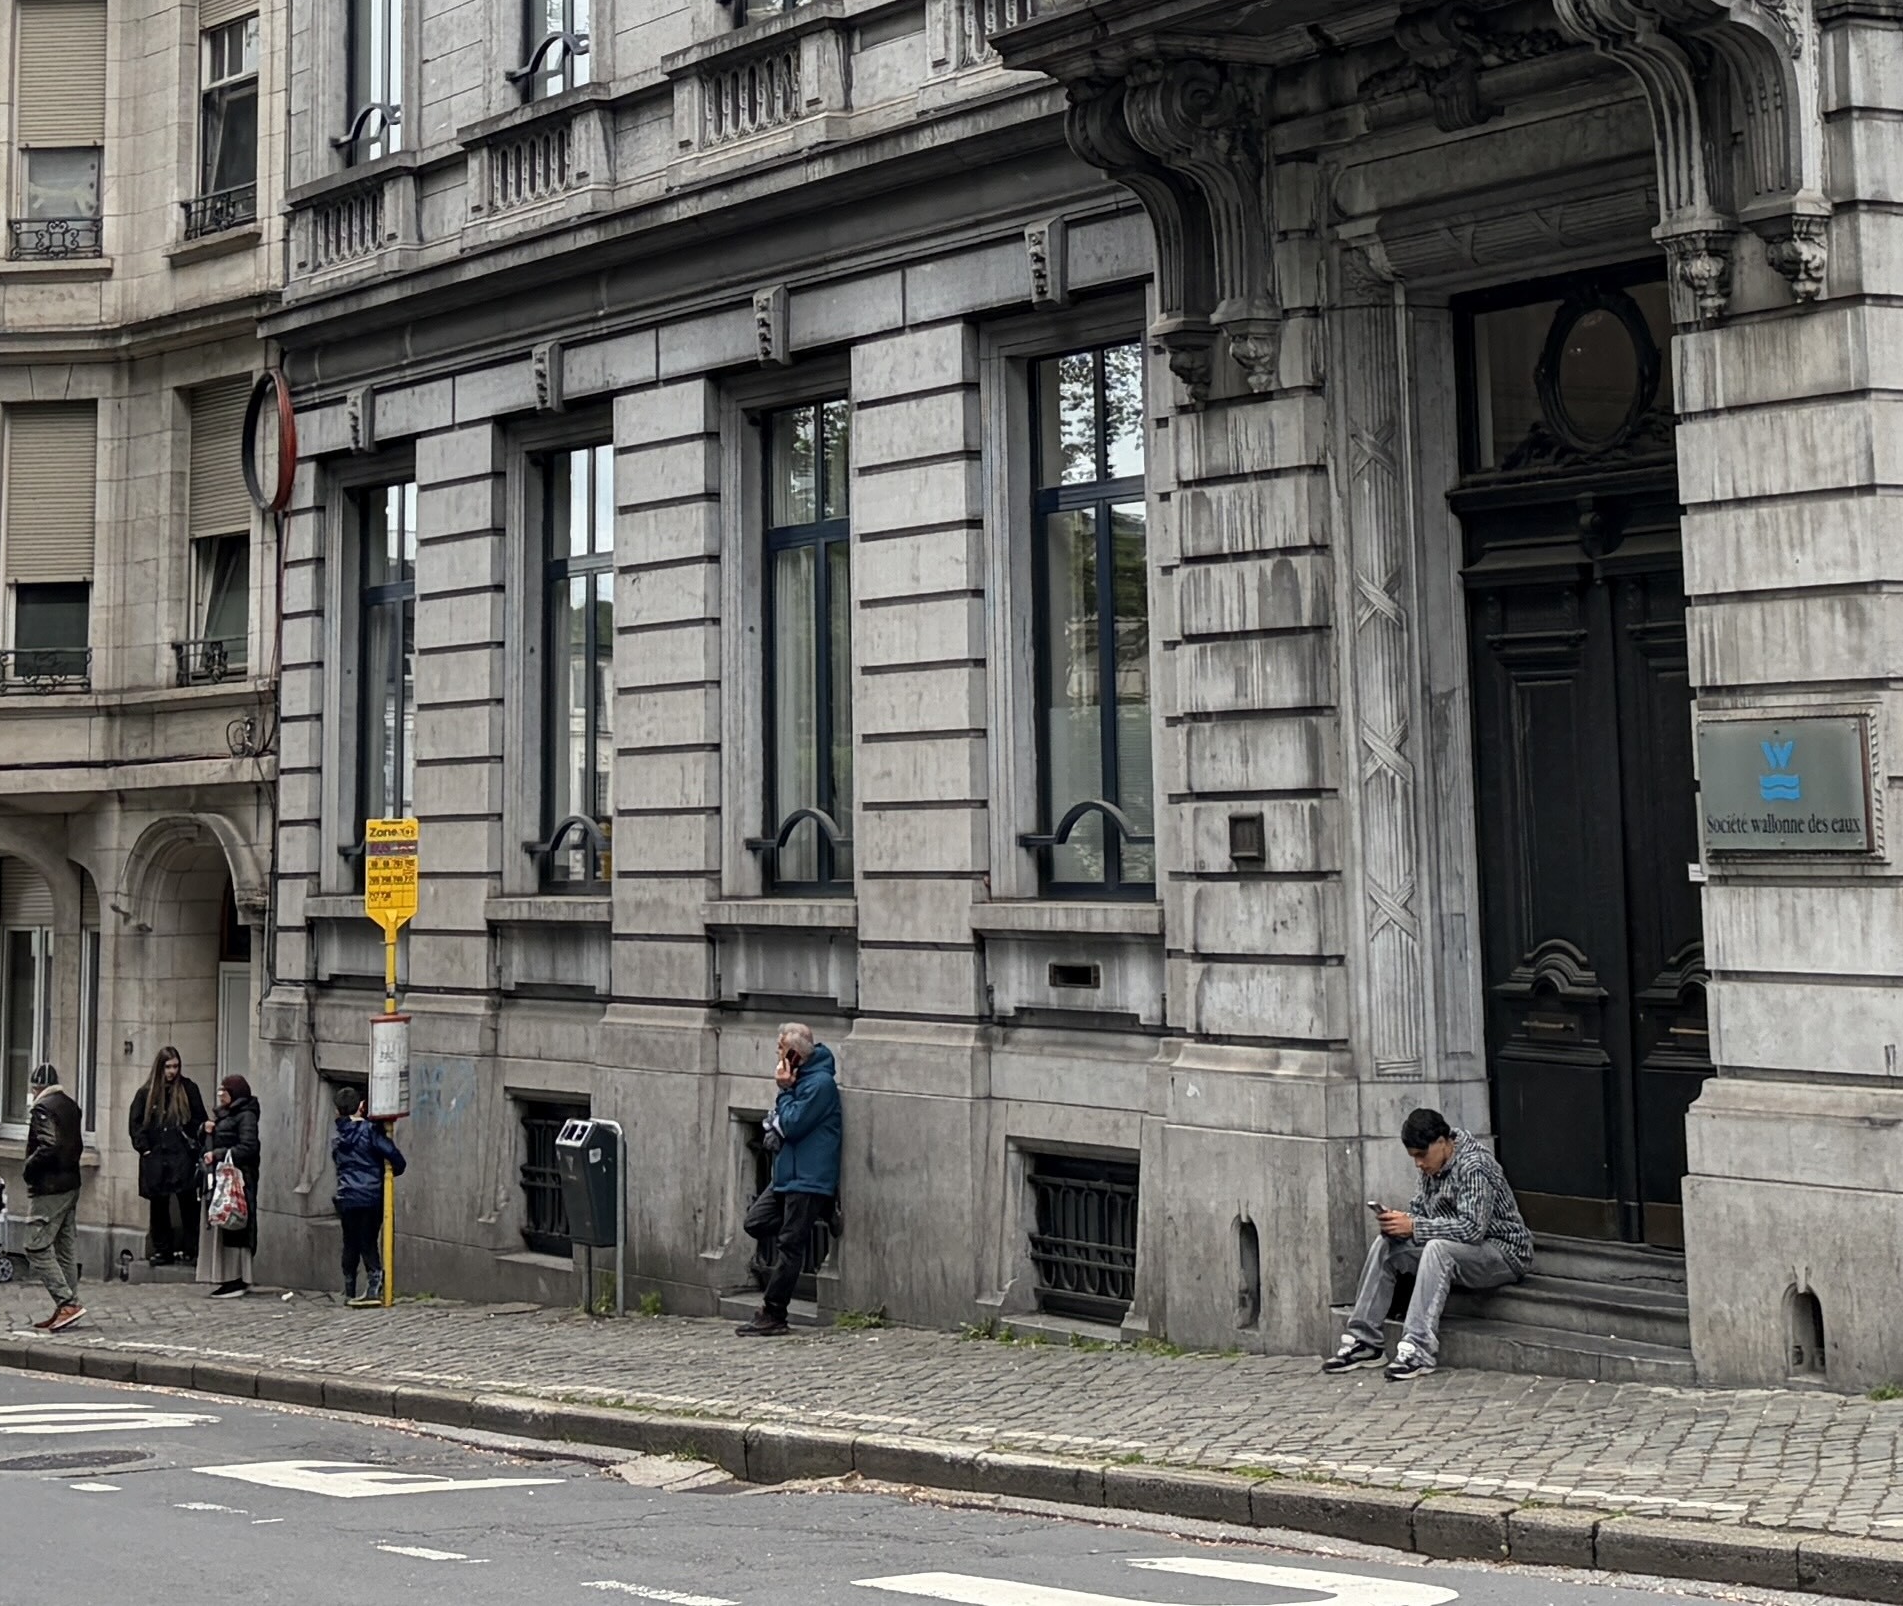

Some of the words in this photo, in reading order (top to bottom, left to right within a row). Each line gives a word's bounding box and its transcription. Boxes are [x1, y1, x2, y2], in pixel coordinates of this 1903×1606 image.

[1706, 812, 1748, 834] Société
[1751, 813, 1805, 834] wallonne
[1807, 813, 1829, 834] des
[1831, 817, 1862, 834] eaux
[369, 828, 397, 838] Zone
